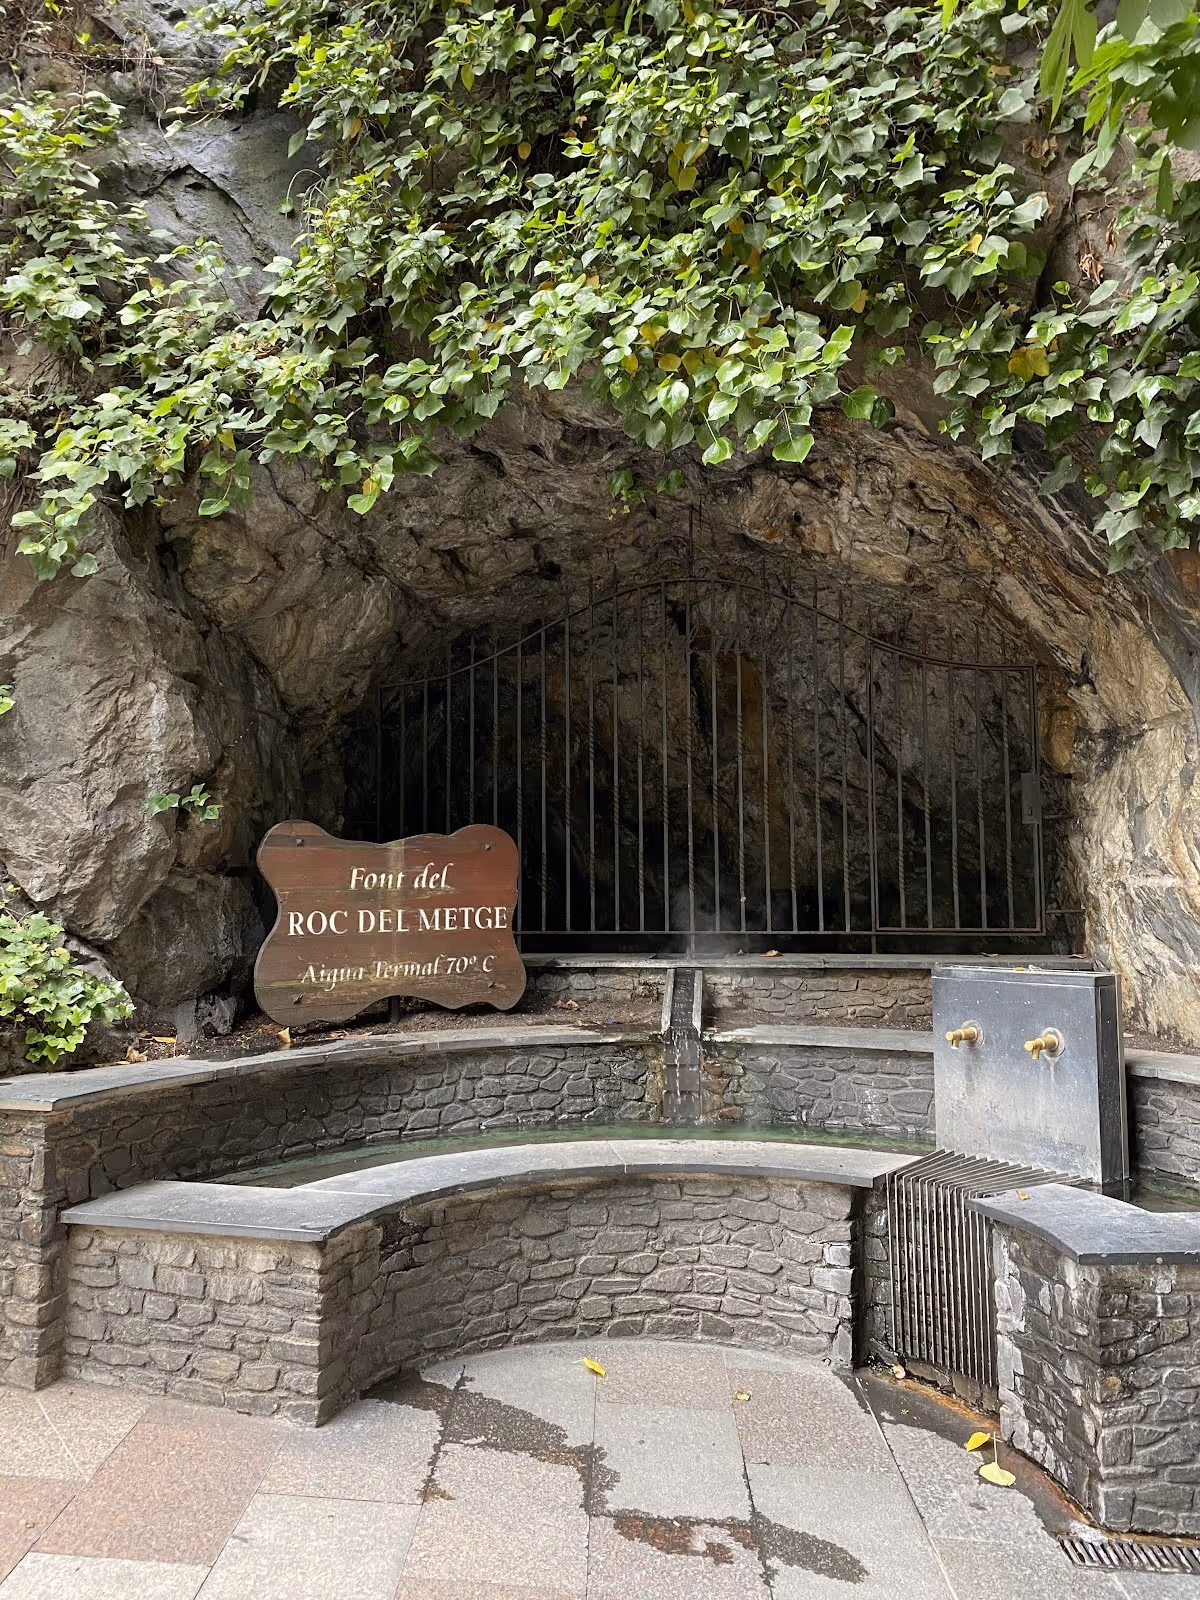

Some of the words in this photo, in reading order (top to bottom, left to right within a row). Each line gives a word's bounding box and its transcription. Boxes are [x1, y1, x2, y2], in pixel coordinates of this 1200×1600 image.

[349, 866, 404, 891] Font
[414, 862, 454, 889] del
[287, 910, 348, 936] ROC
[358, 908, 409, 933] DEL
[418, 906, 508, 932] METGE
[300, 962, 364, 992] Aigua
[373, 954, 444, 978] Termal
[482, 955, 496, 972] C
